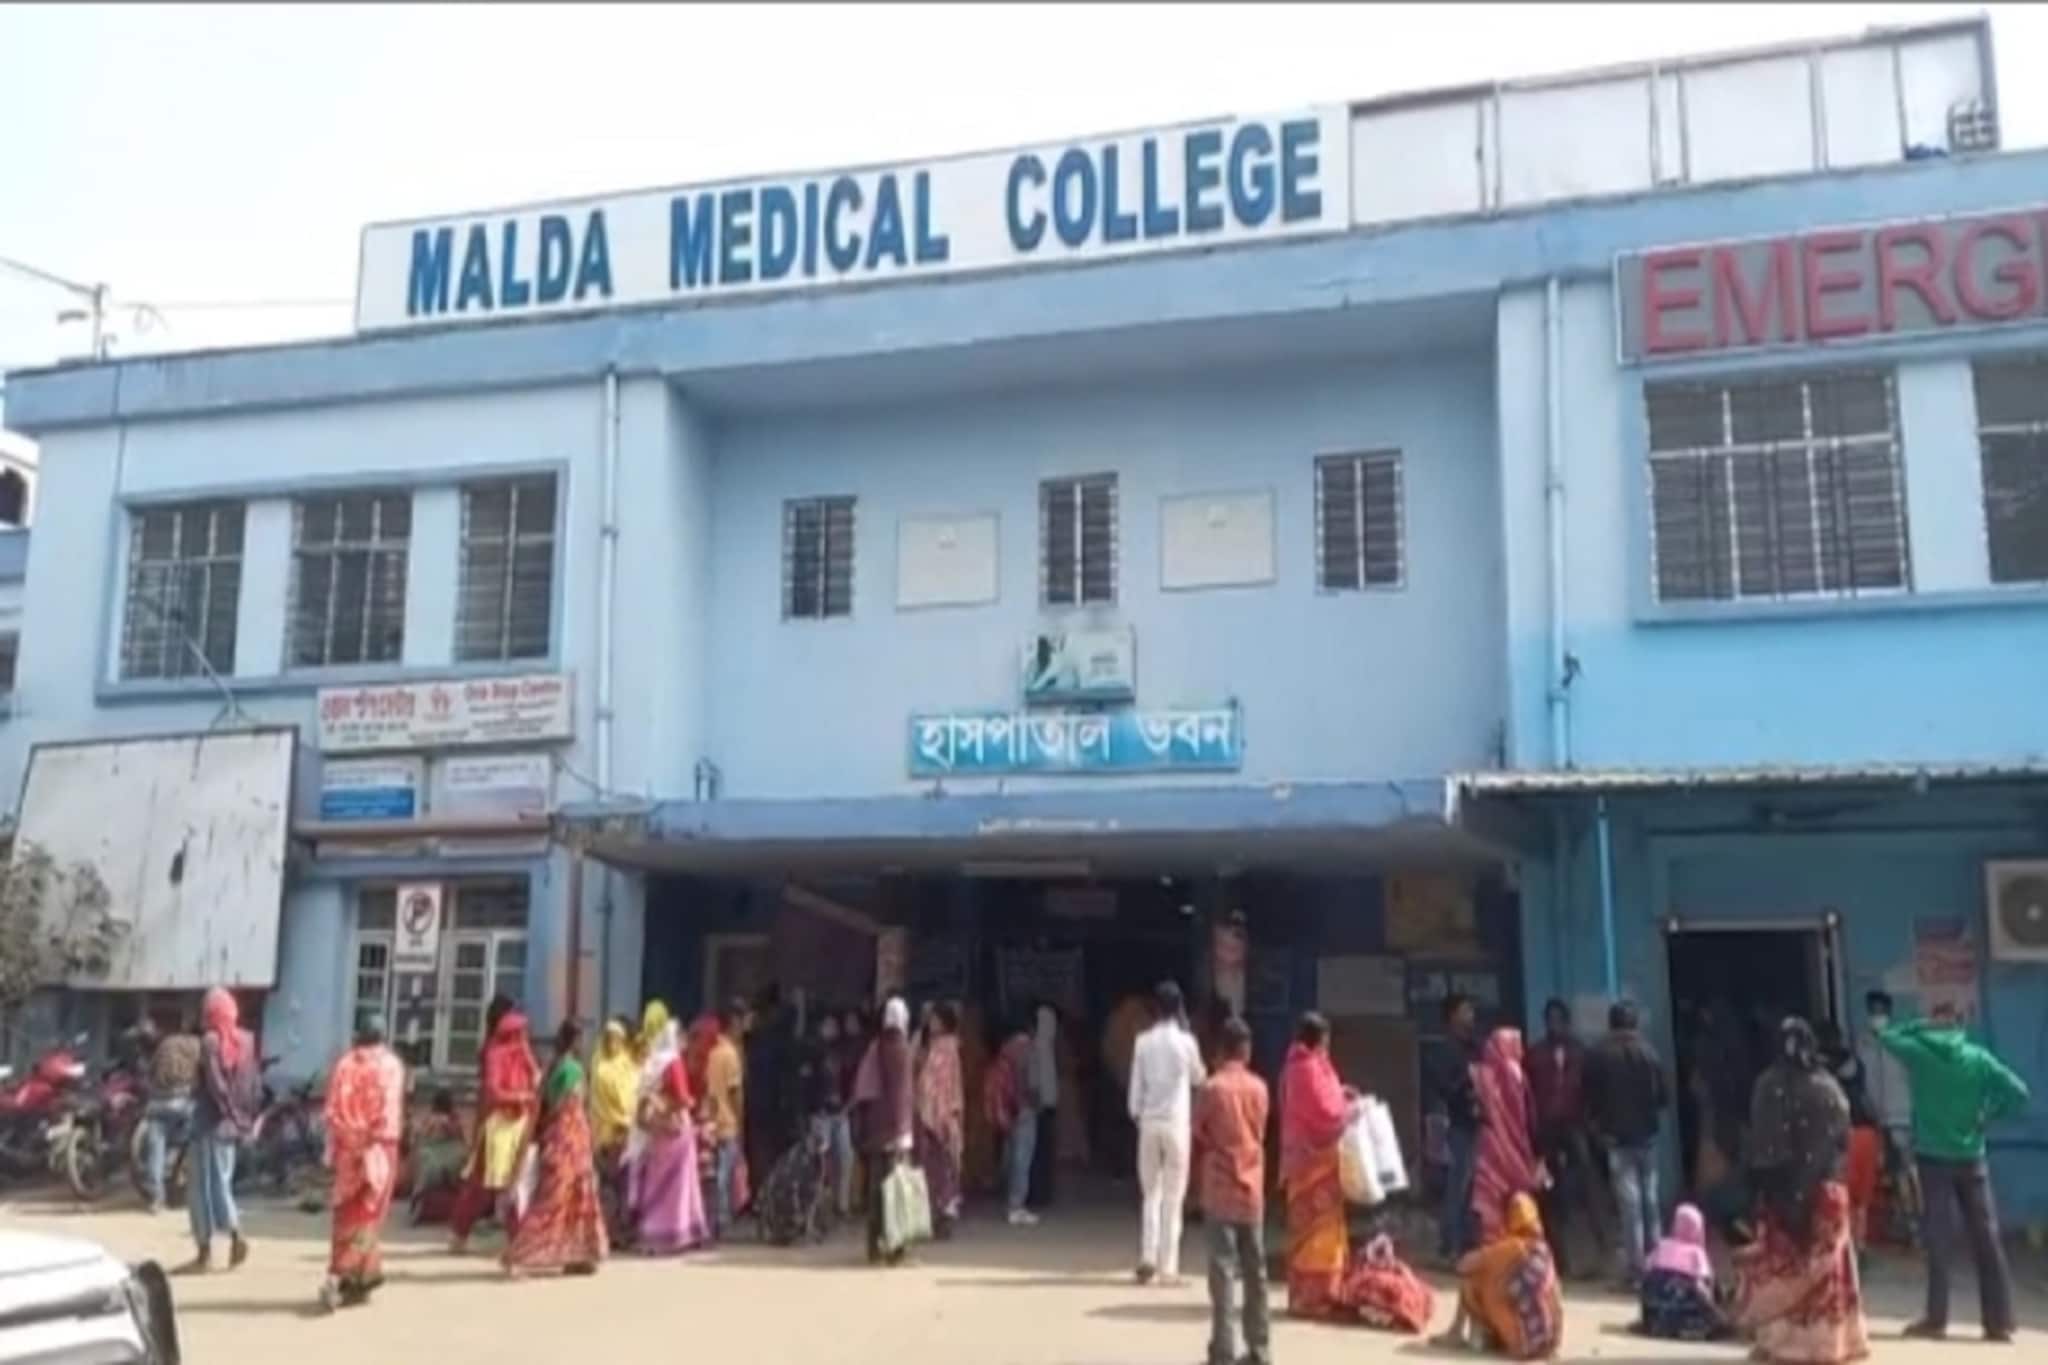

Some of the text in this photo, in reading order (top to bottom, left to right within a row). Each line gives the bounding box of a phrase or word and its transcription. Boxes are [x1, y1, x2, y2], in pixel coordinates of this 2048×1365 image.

[407, 118, 1323, 317] MALDA MEDICAL COLLEGE
[1643, 208, 2048, 356] EMERG
[914, 708, 1234, 771] হাসপাতাল ভবন
